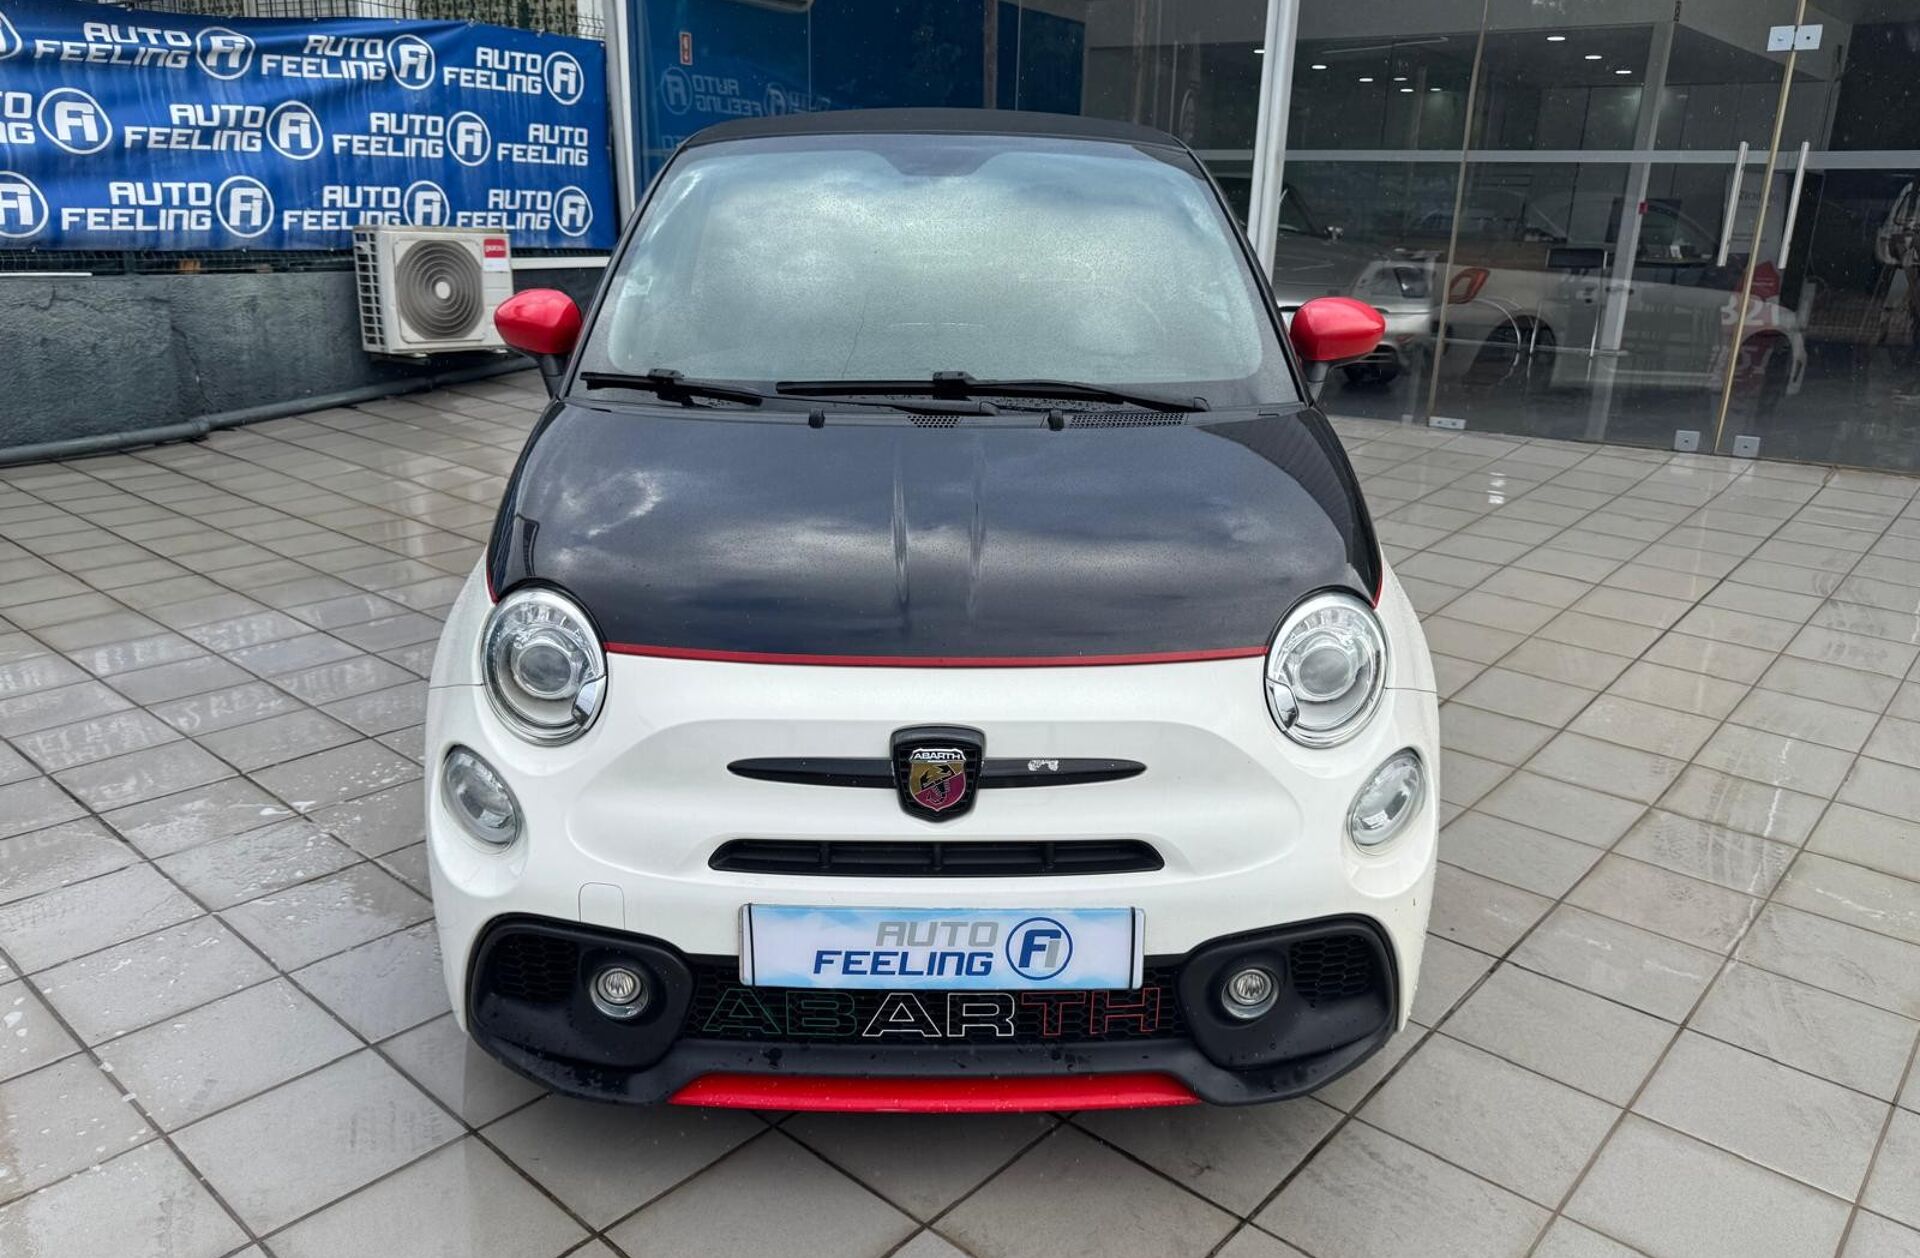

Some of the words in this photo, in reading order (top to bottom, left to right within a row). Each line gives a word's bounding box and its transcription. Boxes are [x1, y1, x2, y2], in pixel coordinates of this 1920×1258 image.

[83, 22, 192, 47] AUTO
[34, 39, 191, 69] FEELING
[303, 35, 384, 59] AUTO
[261, 54, 387, 80] FEELING
[476, 47, 542, 74] AUTO
[443, 67, 543, 95] FEELING
[169, 104, 266, 128] AUTO
[370, 112, 444, 136] AUTO
[124, 126, 262, 152] FEELING
[332, 134, 444, 158] FEELING
[528, 124, 588, 146] AUTO
[497, 143, 588, 166] FEELING
[109, 182, 211, 206] AUTO
[323, 185, 401, 208] AUTO
[488, 189, 552, 210] AUTO
[61, 208, 211, 231] FEELING
[283, 210, 401, 230] FEELING
[456, 211, 552, 230] FEELING
[914, 752, 961, 761] ABARTH
[876, 921, 999, 948] AUTO
[813, 950, 993, 977] FEELING
[702, 987, 1161, 1038] ABARTH
